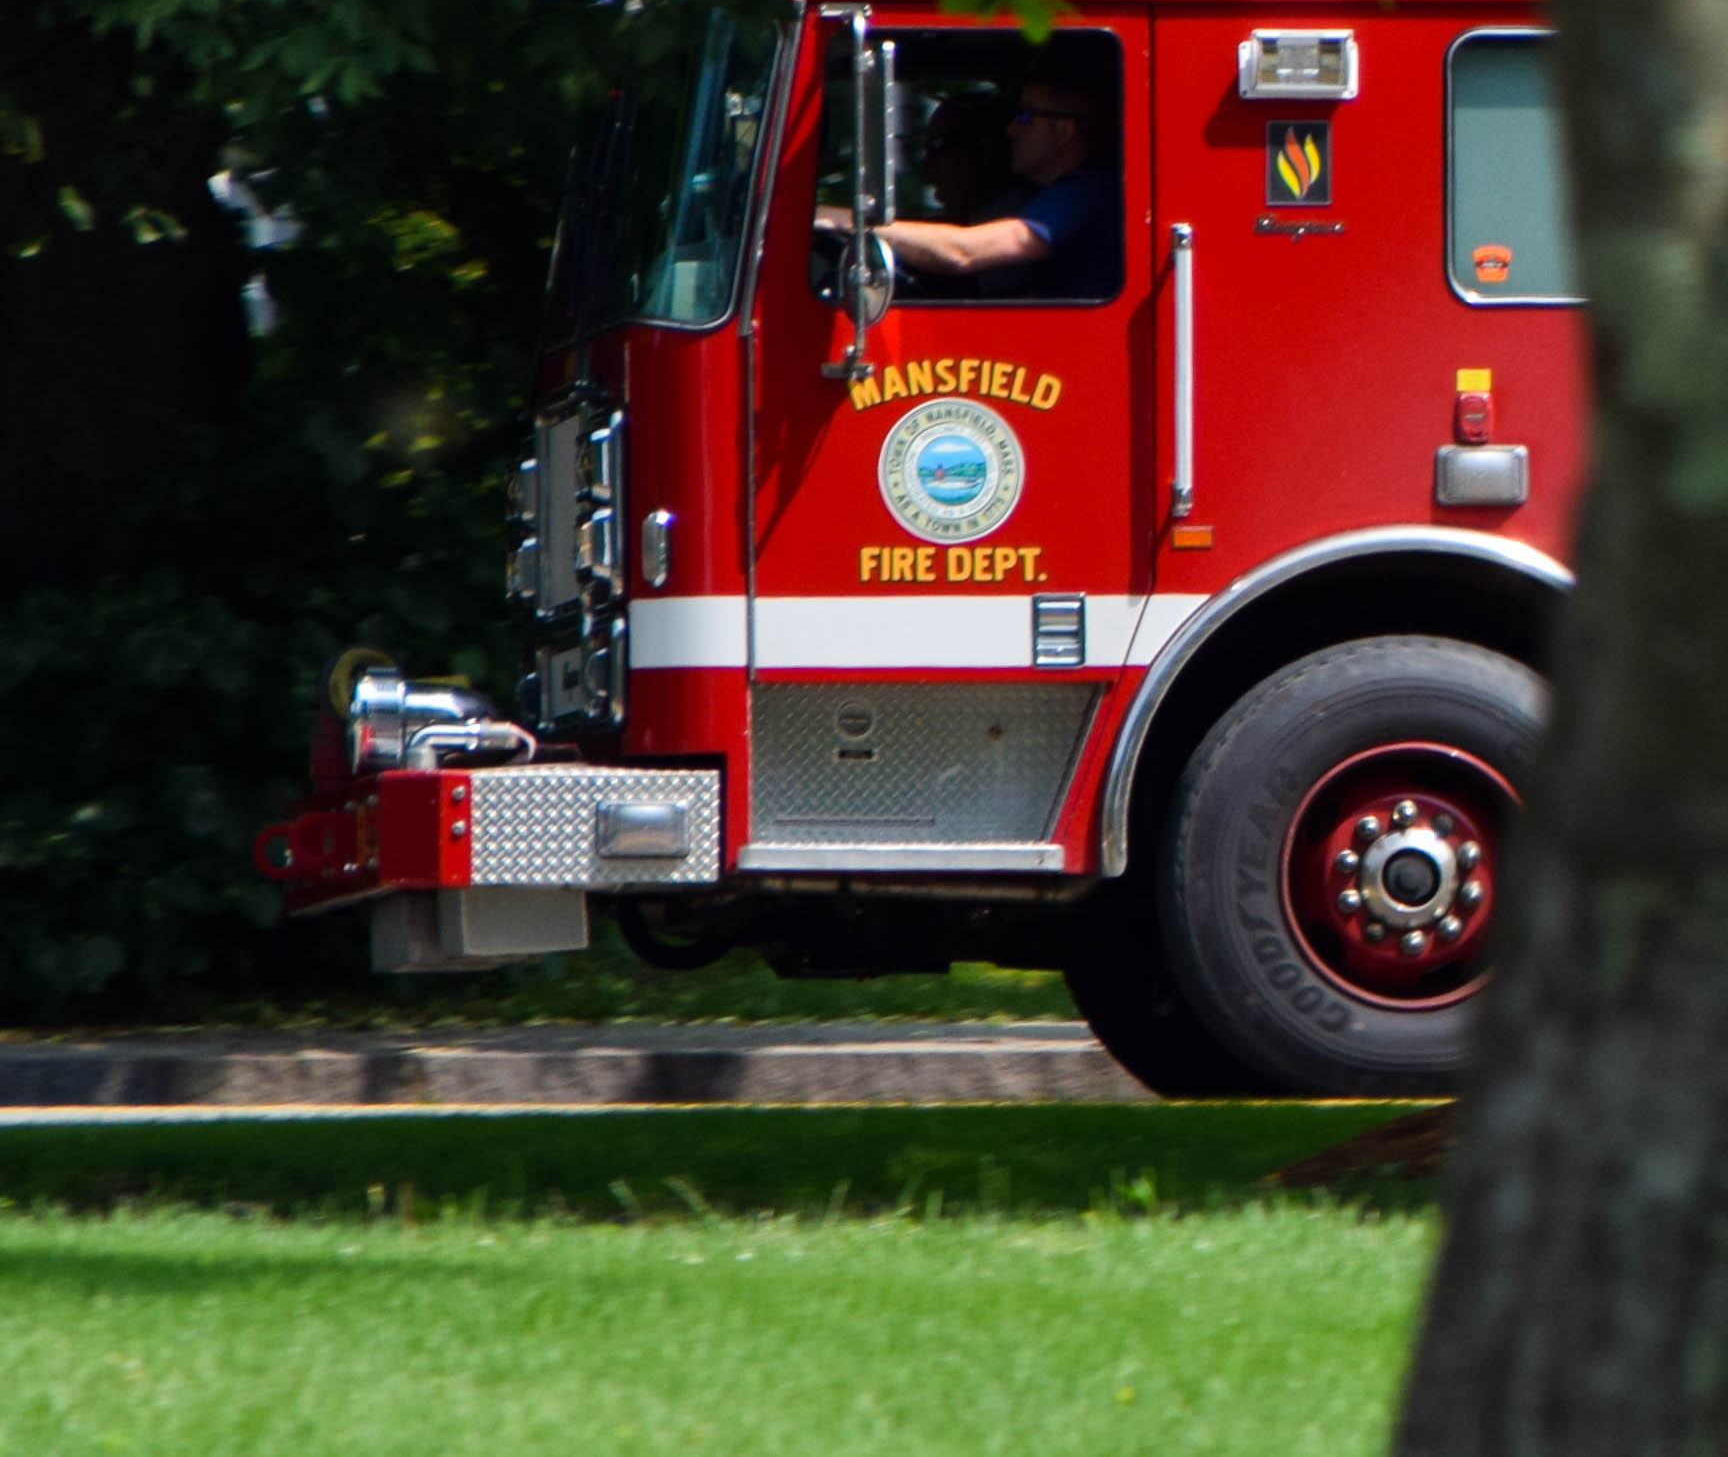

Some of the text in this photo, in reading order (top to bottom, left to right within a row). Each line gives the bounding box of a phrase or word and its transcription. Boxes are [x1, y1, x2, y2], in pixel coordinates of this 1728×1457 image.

[849, 358, 1062, 410] MANSFIELD
[860, 546, 1048, 582] FIRE DEPT.
[1236, 765, 1351, 1032] GOODYEAR
